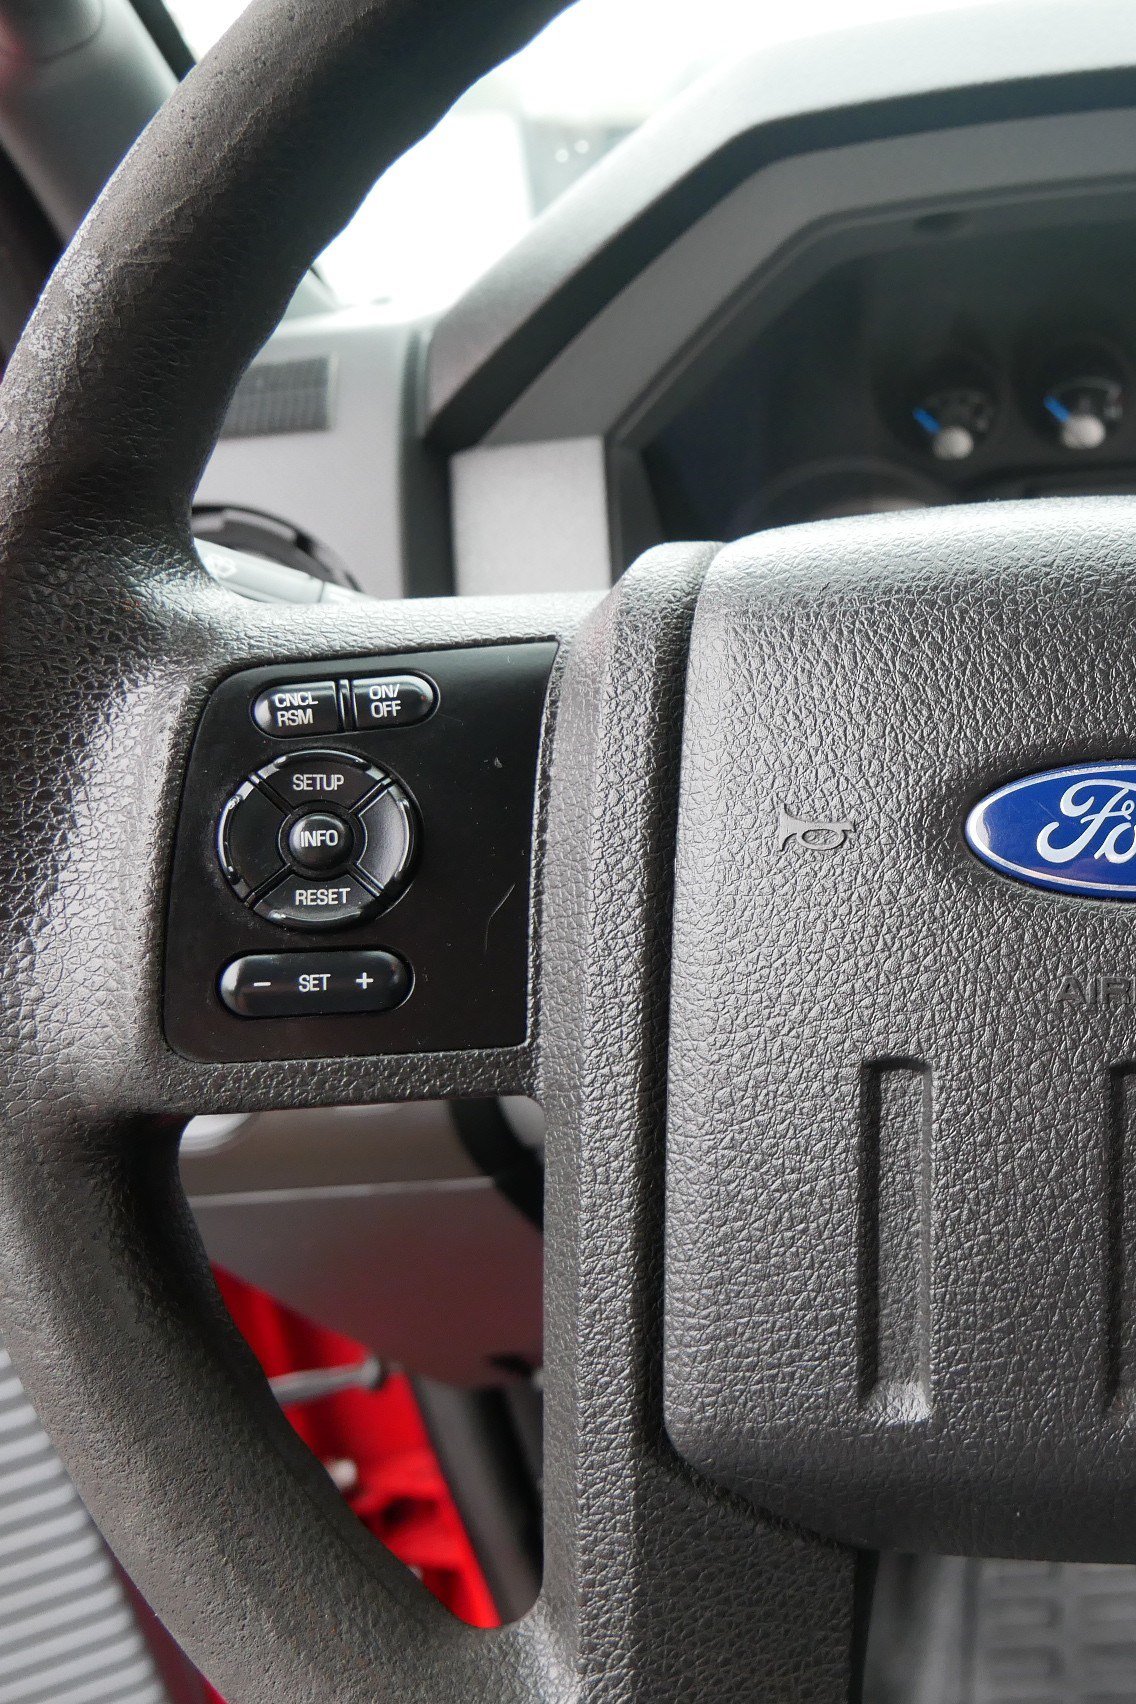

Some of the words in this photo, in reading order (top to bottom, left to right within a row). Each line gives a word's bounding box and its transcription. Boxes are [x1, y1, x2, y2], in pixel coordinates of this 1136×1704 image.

[274, 691, 318, 707] CNCL
[369, 684, 400, 700] ON/
[277, 708, 314, 727] RSM
[371, 701, 402, 718] OFF
[292, 774, 344, 791] SETUP
[300, 829, 339, 847] INFO
[295, 888, 350, 906] RESET
[298, 974, 331, 992] SET
